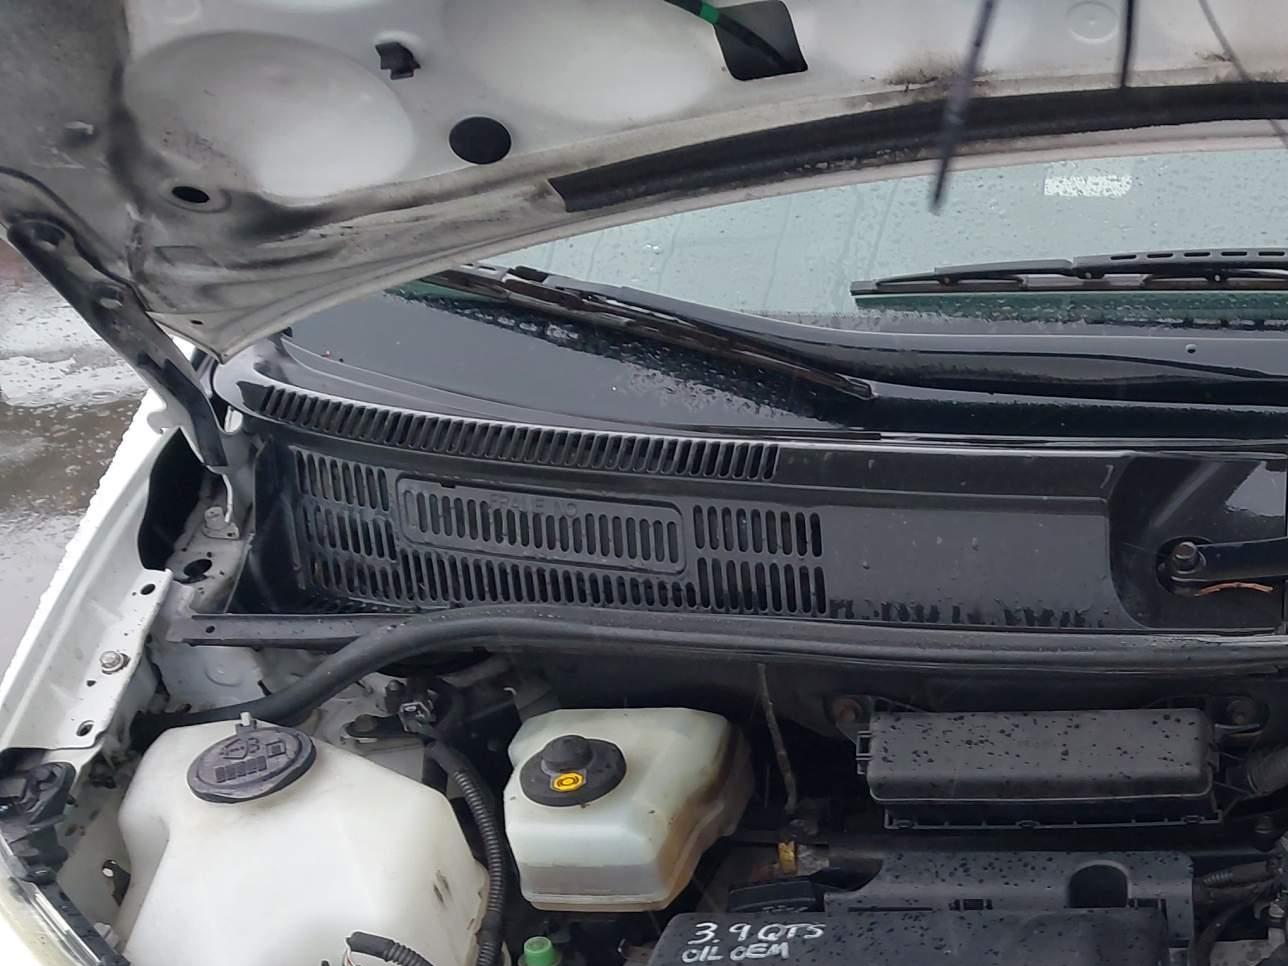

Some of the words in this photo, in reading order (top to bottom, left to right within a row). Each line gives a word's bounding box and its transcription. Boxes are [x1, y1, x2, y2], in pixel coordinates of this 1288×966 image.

[757, 922, 827, 941] QTS
[681, 945, 724, 963] OIL
[729, 941, 790, 961] OEM
